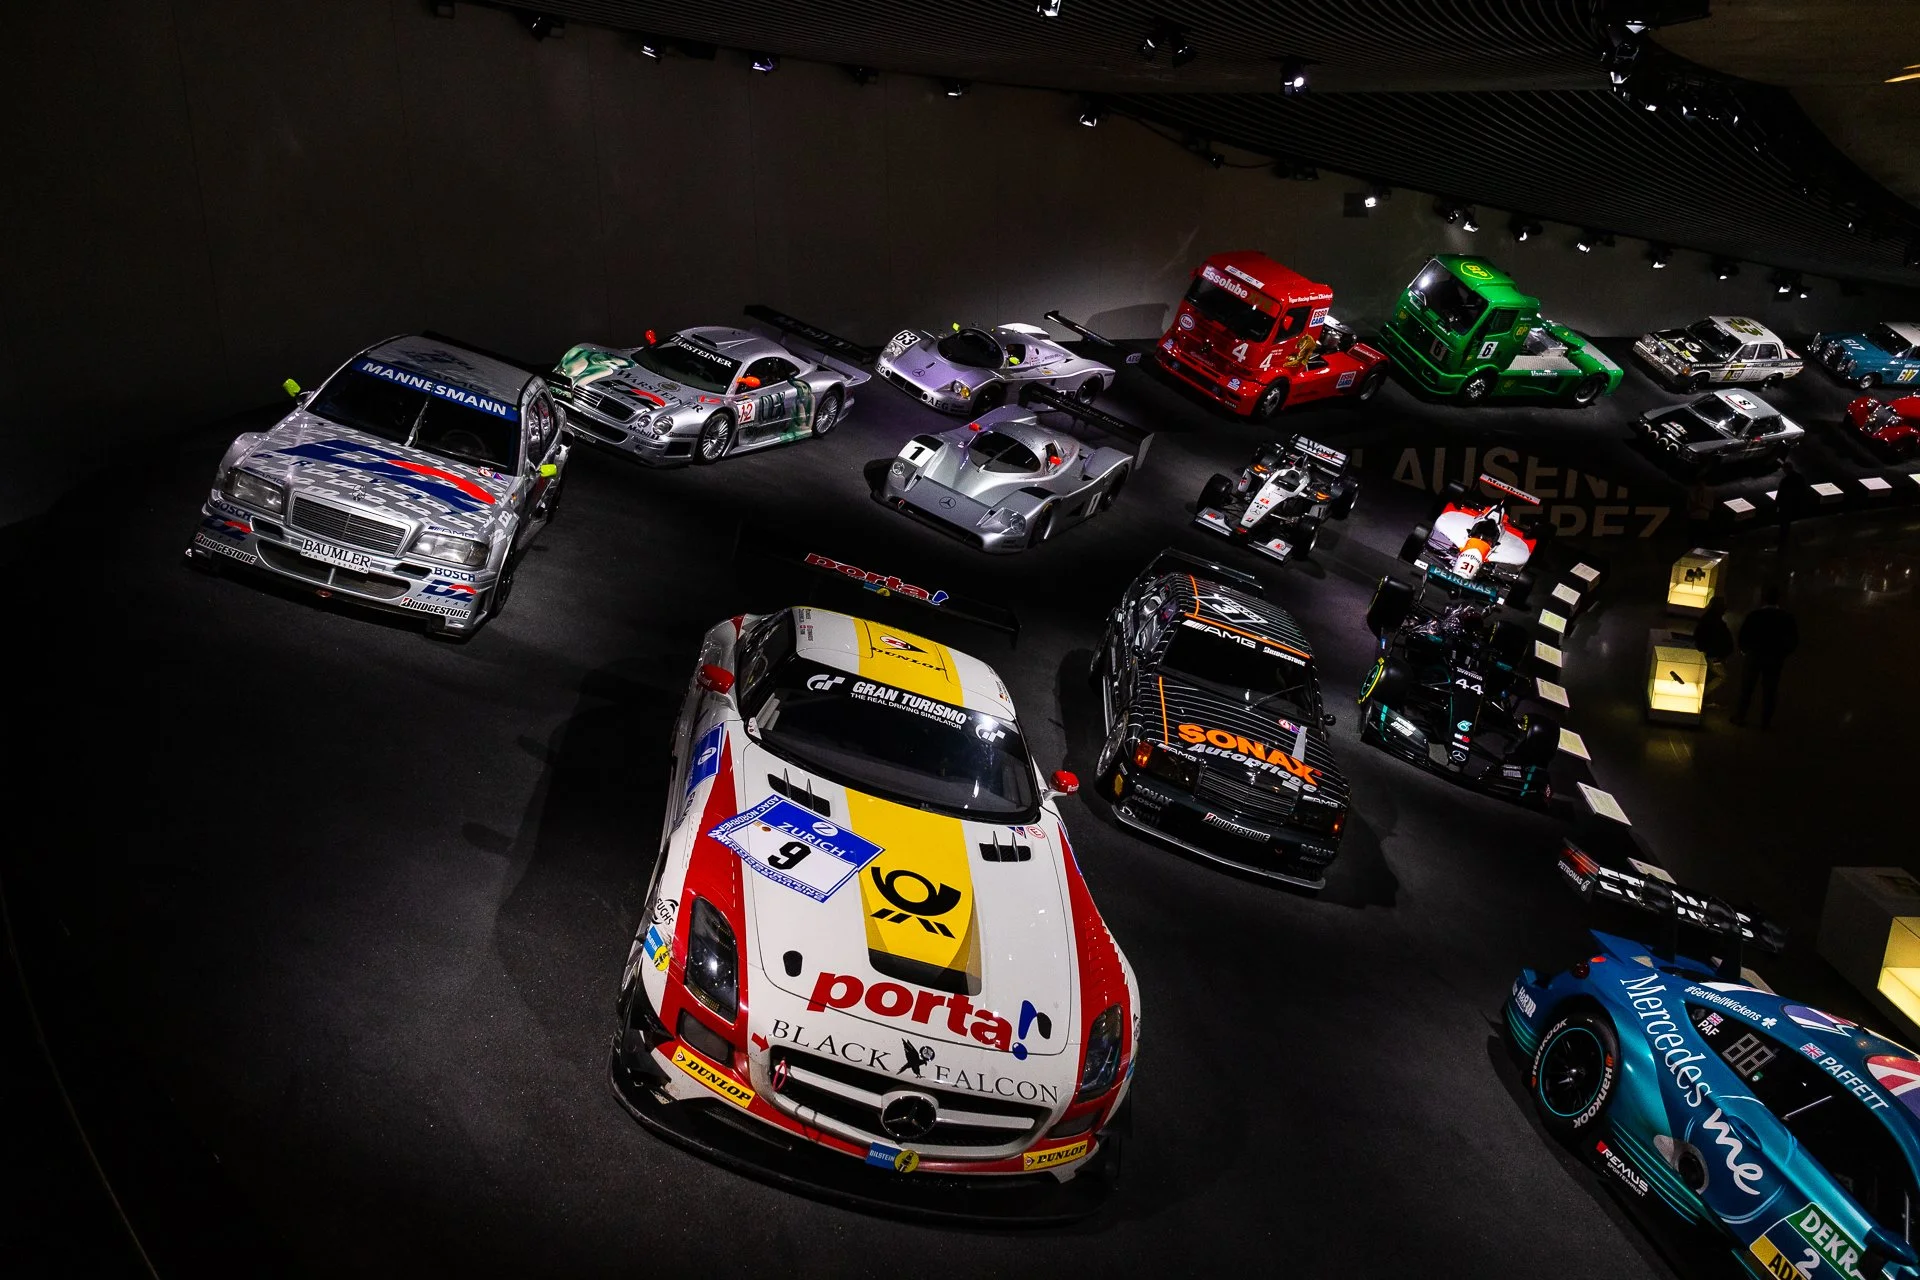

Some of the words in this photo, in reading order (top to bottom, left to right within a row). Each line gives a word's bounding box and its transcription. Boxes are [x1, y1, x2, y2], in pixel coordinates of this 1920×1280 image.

[1466, 264, 1488, 278] BP
[1311, 317, 1325, 325] CARD
[1314, 309, 1327, 318] ESSO
[895, 331, 917, 346] 63
[1516, 325, 1528, 337] BP
[1127, 353, 1140, 364] AEG
[1231, 342, 1249, 363] 4
[1481, 343, 1492, 357] 6
[877, 363, 886, 374] EG
[1259, 353, 1272, 371] 4
[362, 362, 507, 416] MANNESMANN
[740, 403, 753, 423] 12
[928, 397, 949, 410] AEG
[908, 446, 926, 461] 1
[1306, 439, 1338, 460] West
[1487, 476, 1535, 503] Marlboro
[213, 499, 252, 521] BOSCH
[195, 532, 257, 564] BRIDGESTONE
[434, 567, 476, 582] BOSCH
[1461, 561, 1474, 574] 31
[422, 579, 478, 603] D2
[1434, 566, 1491, 594] PETRONAS
[401, 597, 471, 619] BRIDGESTONE
[872, 647, 948, 673] DUNLOP
[1263, 646, 1306, 667] BRIDGESTONE
[1455, 678, 1484, 696] 44
[850, 692, 867, 701] THE
[867, 695, 887, 707] REAL
[888, 700, 919, 716] DRIVING
[920, 710, 962, 730] SIMULATOR
[852, 680, 898, 702] GRAN
[901, 691, 967, 725] TURISMO
[1169, 746, 1197, 762] AMG
[1177, 723, 1319, 786] SONAX
[1188, 742, 1318, 793] Autopflege
[756, 796, 780, 812] ADAC
[1131, 794, 1162, 811] BOSCH
[1135, 784, 1173, 807] SONAX
[1202, 811, 1271, 844] BRIDGESTONE
[777, 821, 846, 857] ZURICH
[767, 841, 811, 870] 9
[1558, 860, 1583, 886] PETRONAS
[656, 898, 674, 925] FUCHS
[1684, 985, 1762, 1022] #GetWellWickens
[806, 971, 1028, 1061] porta!
[1697, 1019, 1720, 1037] PAF
[772, 1018, 891, 1073] BLACK
[934, 1064, 1060, 1104] FALCON
[686, 1059, 752, 1102] DUNLOP
[1619, 972, 1713, 1108] Mercedes
[1702, 1107, 1764, 1196] me
[1819, 1056, 1889, 1110] PAFFETT
[869, 1149, 895, 1163] BILSTEIN
[1036, 1145, 1086, 1164] DUNLOP
[1602, 1146, 1649, 1193] REMUS
[1606, 1160, 1646, 1198] SPORTEXHAUST
[1794, 1247, 1821, 1280] 2
